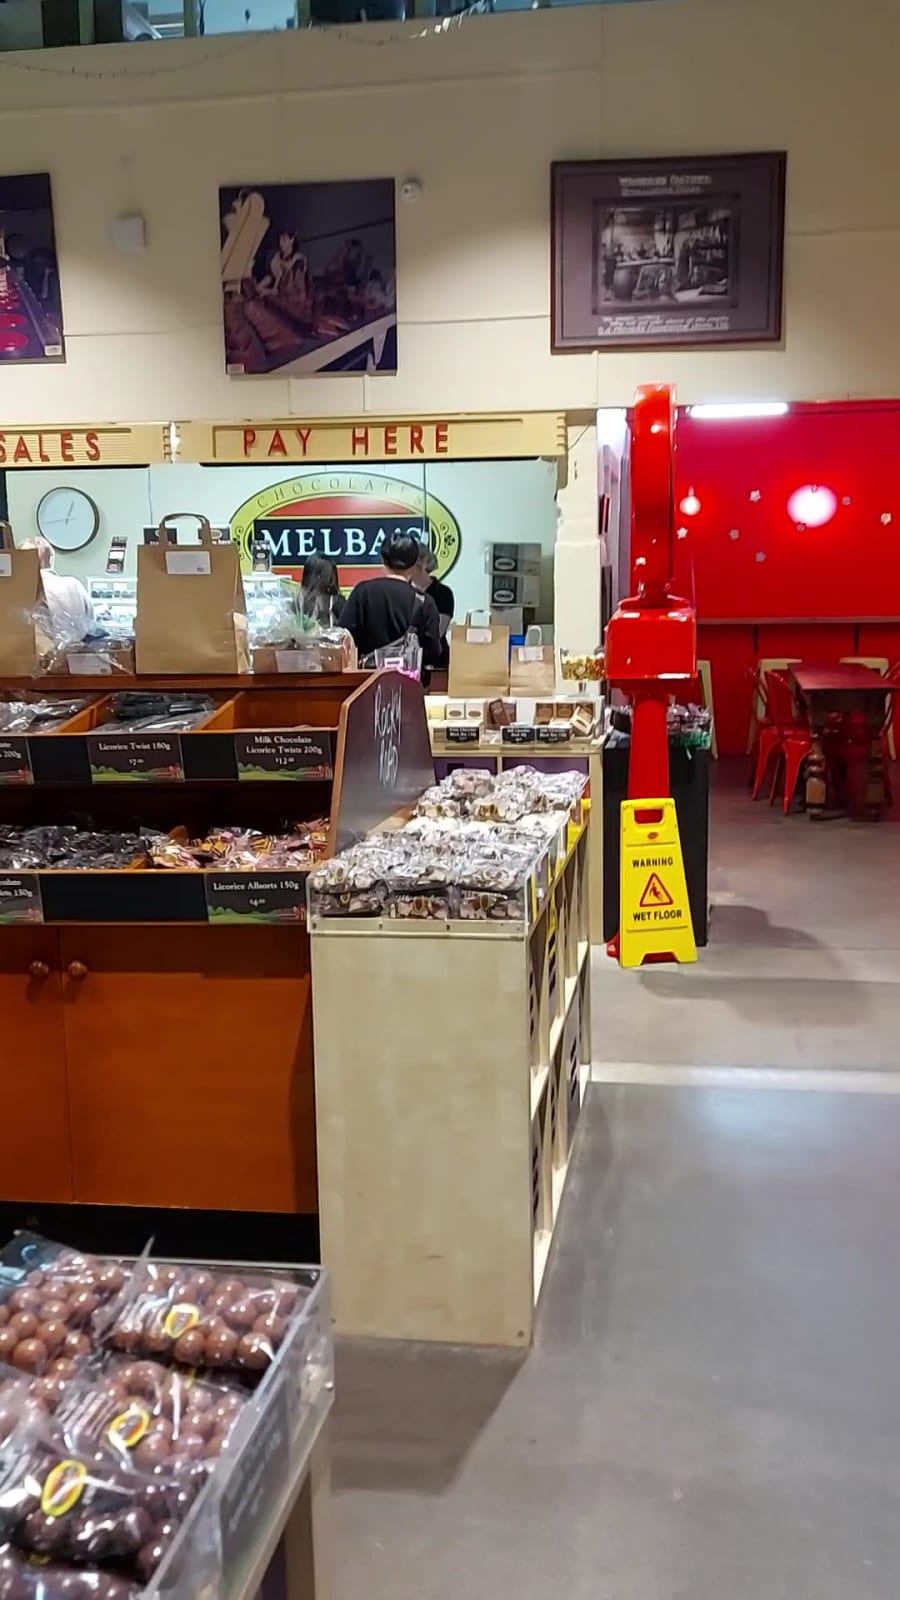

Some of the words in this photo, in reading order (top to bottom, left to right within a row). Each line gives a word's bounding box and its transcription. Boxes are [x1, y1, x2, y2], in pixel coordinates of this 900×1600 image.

[243, 428, 312, 457] PAY
[352, 423, 449, 455] HERE
[254, 735, 272, 744] Milk
[273, 735, 312, 744] Chocolate
[98, 743, 128, 751] Licorice
[129, 742, 151, 750] Twist
[246, 746, 276, 754] Licorice
[277, 745, 302, 754] Twists
[632, 856, 674, 868] WARNING
[213, 883, 245, 891] Licorice
[247, 881, 277, 890] Allsorts
[280, 881, 299, 891] 150g
[633, 911, 651, 922] WET
[653, 909, 682, 920] FLOOR
